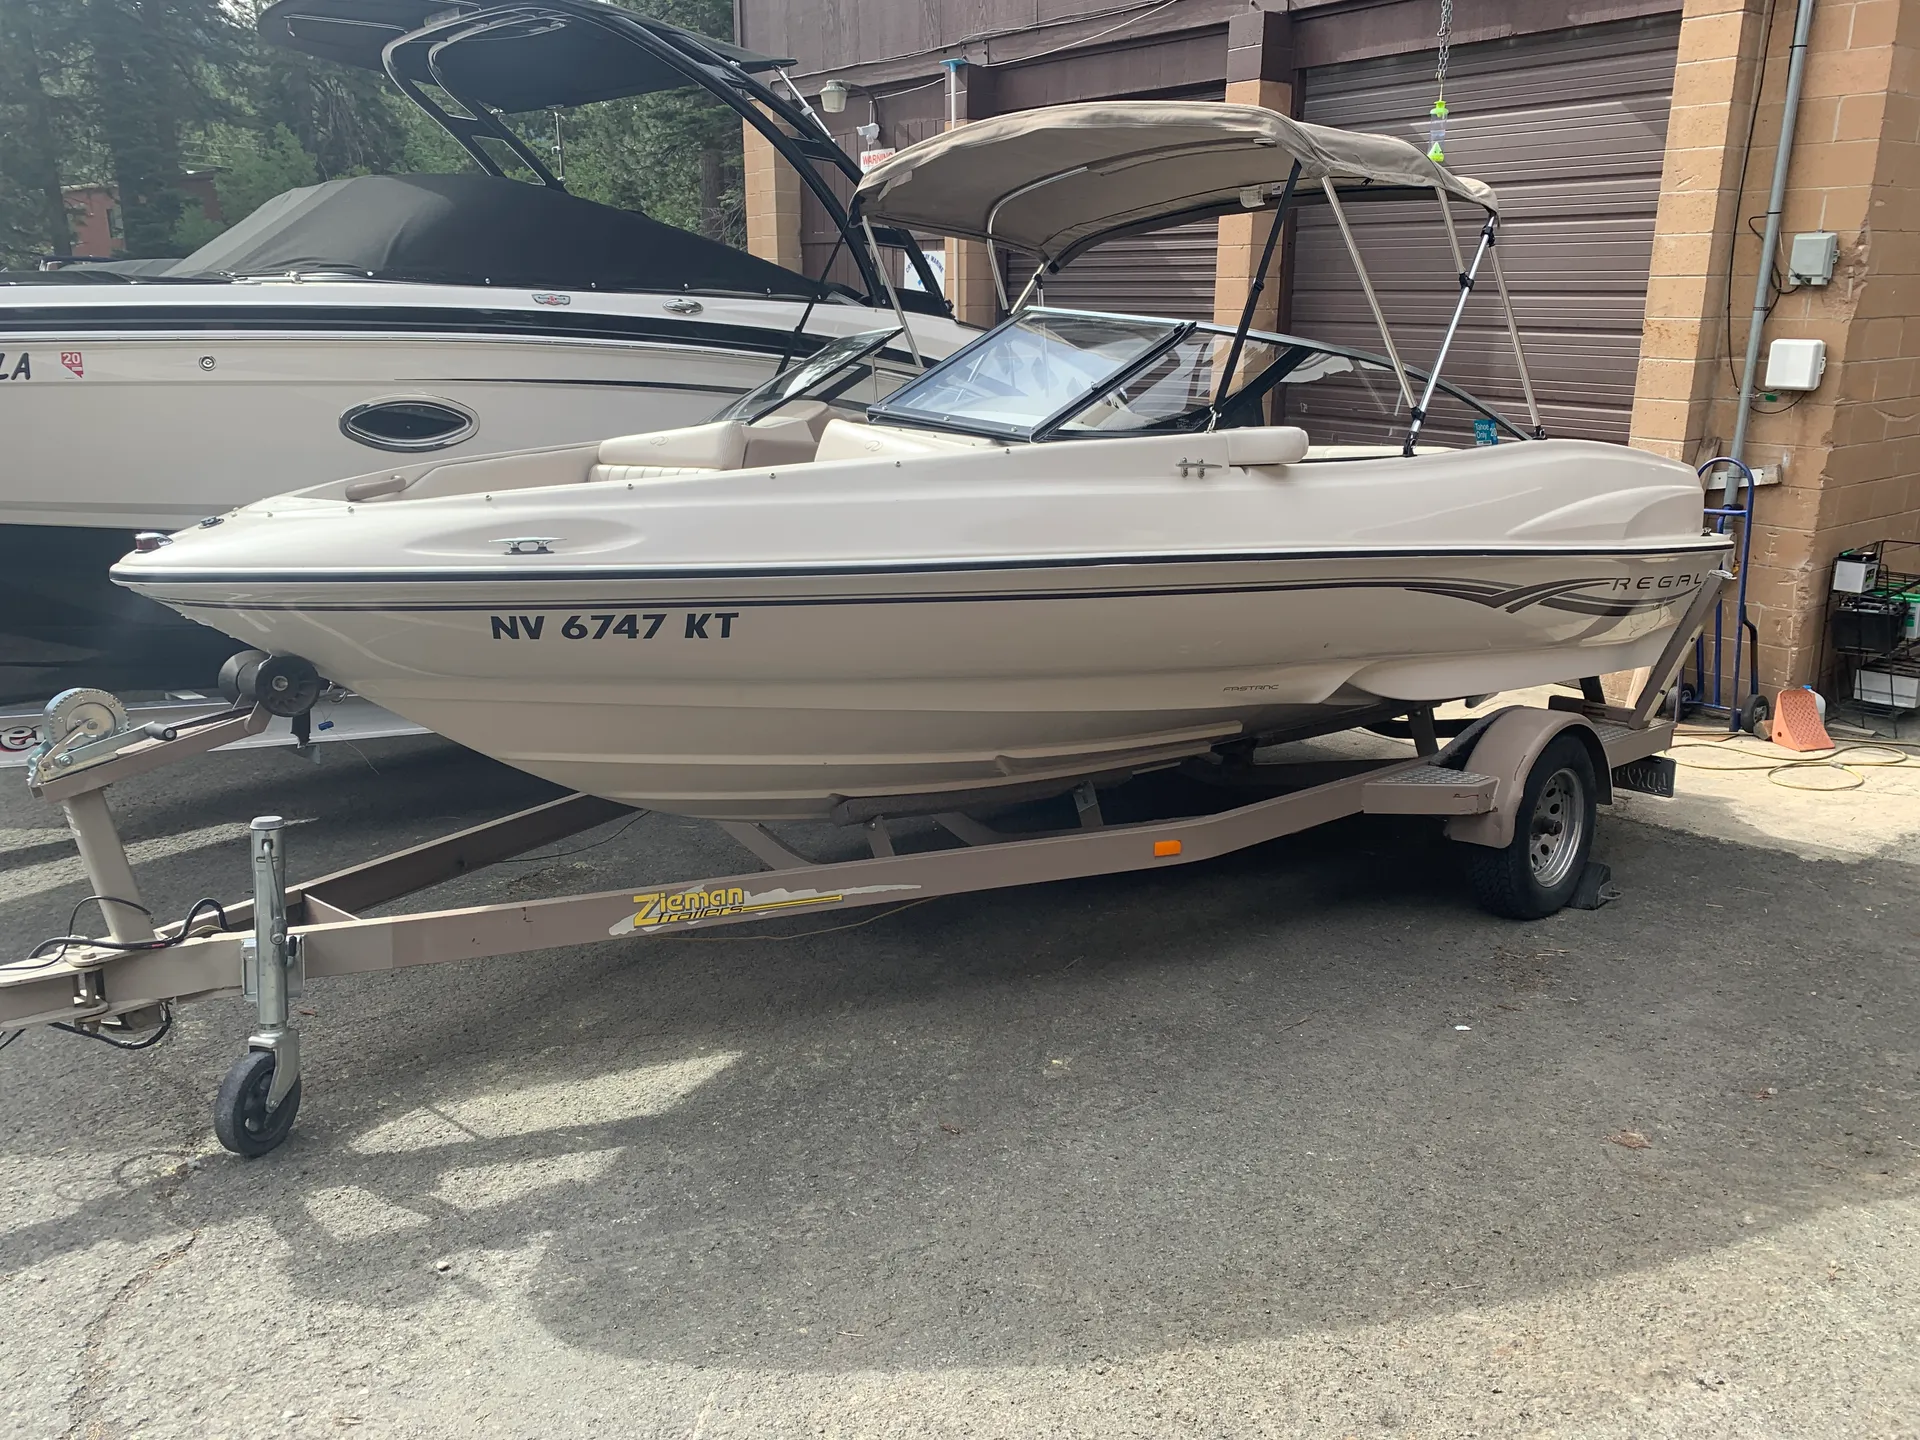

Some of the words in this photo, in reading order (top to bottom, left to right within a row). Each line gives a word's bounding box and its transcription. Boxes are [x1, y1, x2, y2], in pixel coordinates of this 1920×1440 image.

[62, 353, 81, 364] 20
[1474, 422, 1489, 431] Tahoe
[1476, 431, 1487, 440] Only
[1612, 573, 1702, 591] REGAL
[490, 615, 545, 640] NV
[561, 613, 667, 640] 6747
[684, 612, 740, 639] KT
[633, 887, 745, 927] Zieman
[657, 904, 744, 924] Trailers
